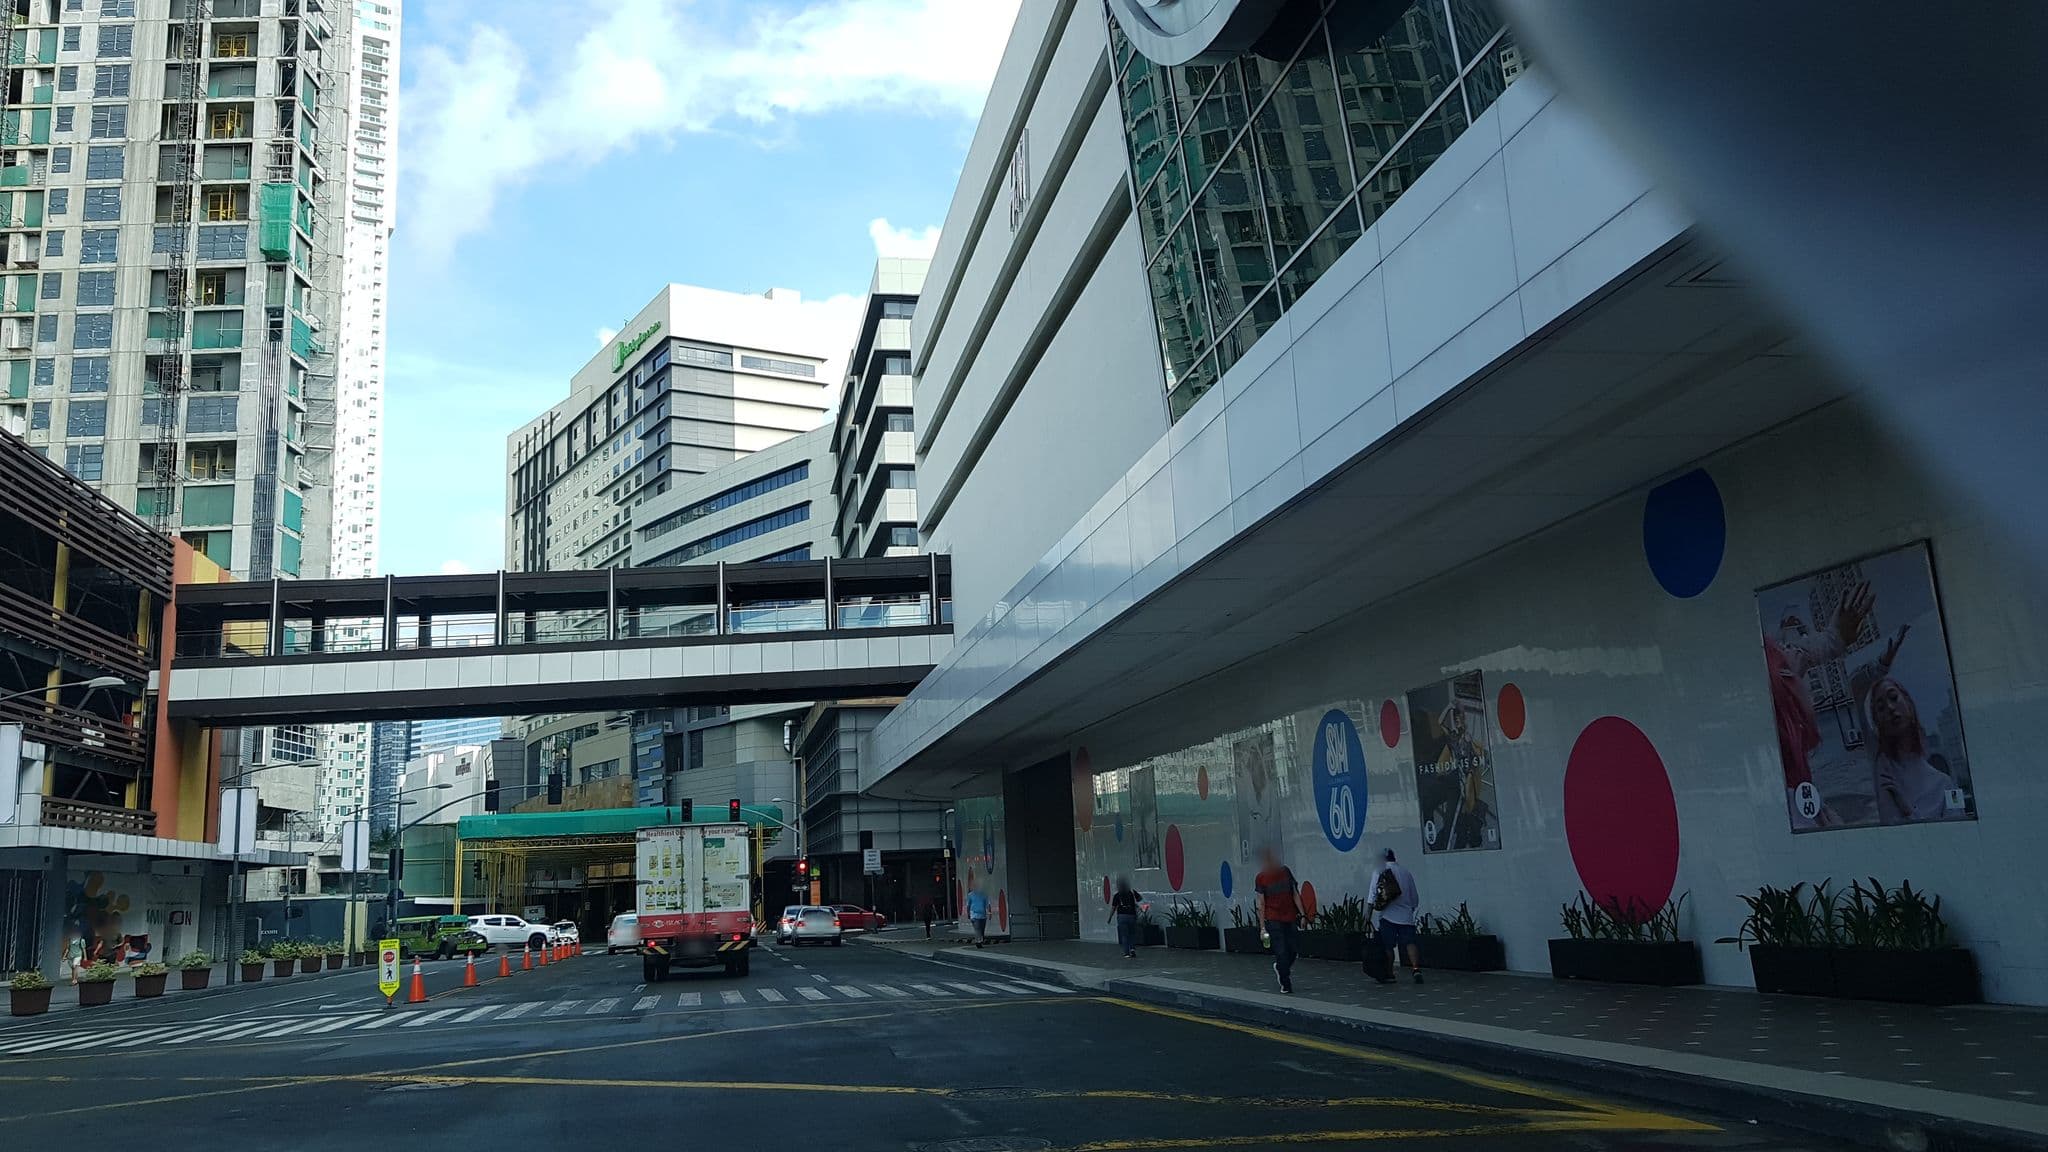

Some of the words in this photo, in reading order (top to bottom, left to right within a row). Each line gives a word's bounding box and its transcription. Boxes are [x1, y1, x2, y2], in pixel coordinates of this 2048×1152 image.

[1325, 722, 1349, 776] SM
[1418, 760, 1457, 774] FASHION
[1461, 757, 1470, 769] IS
[1329, 785, 1355, 840] 60
[1803, 801, 1815, 816] 60
